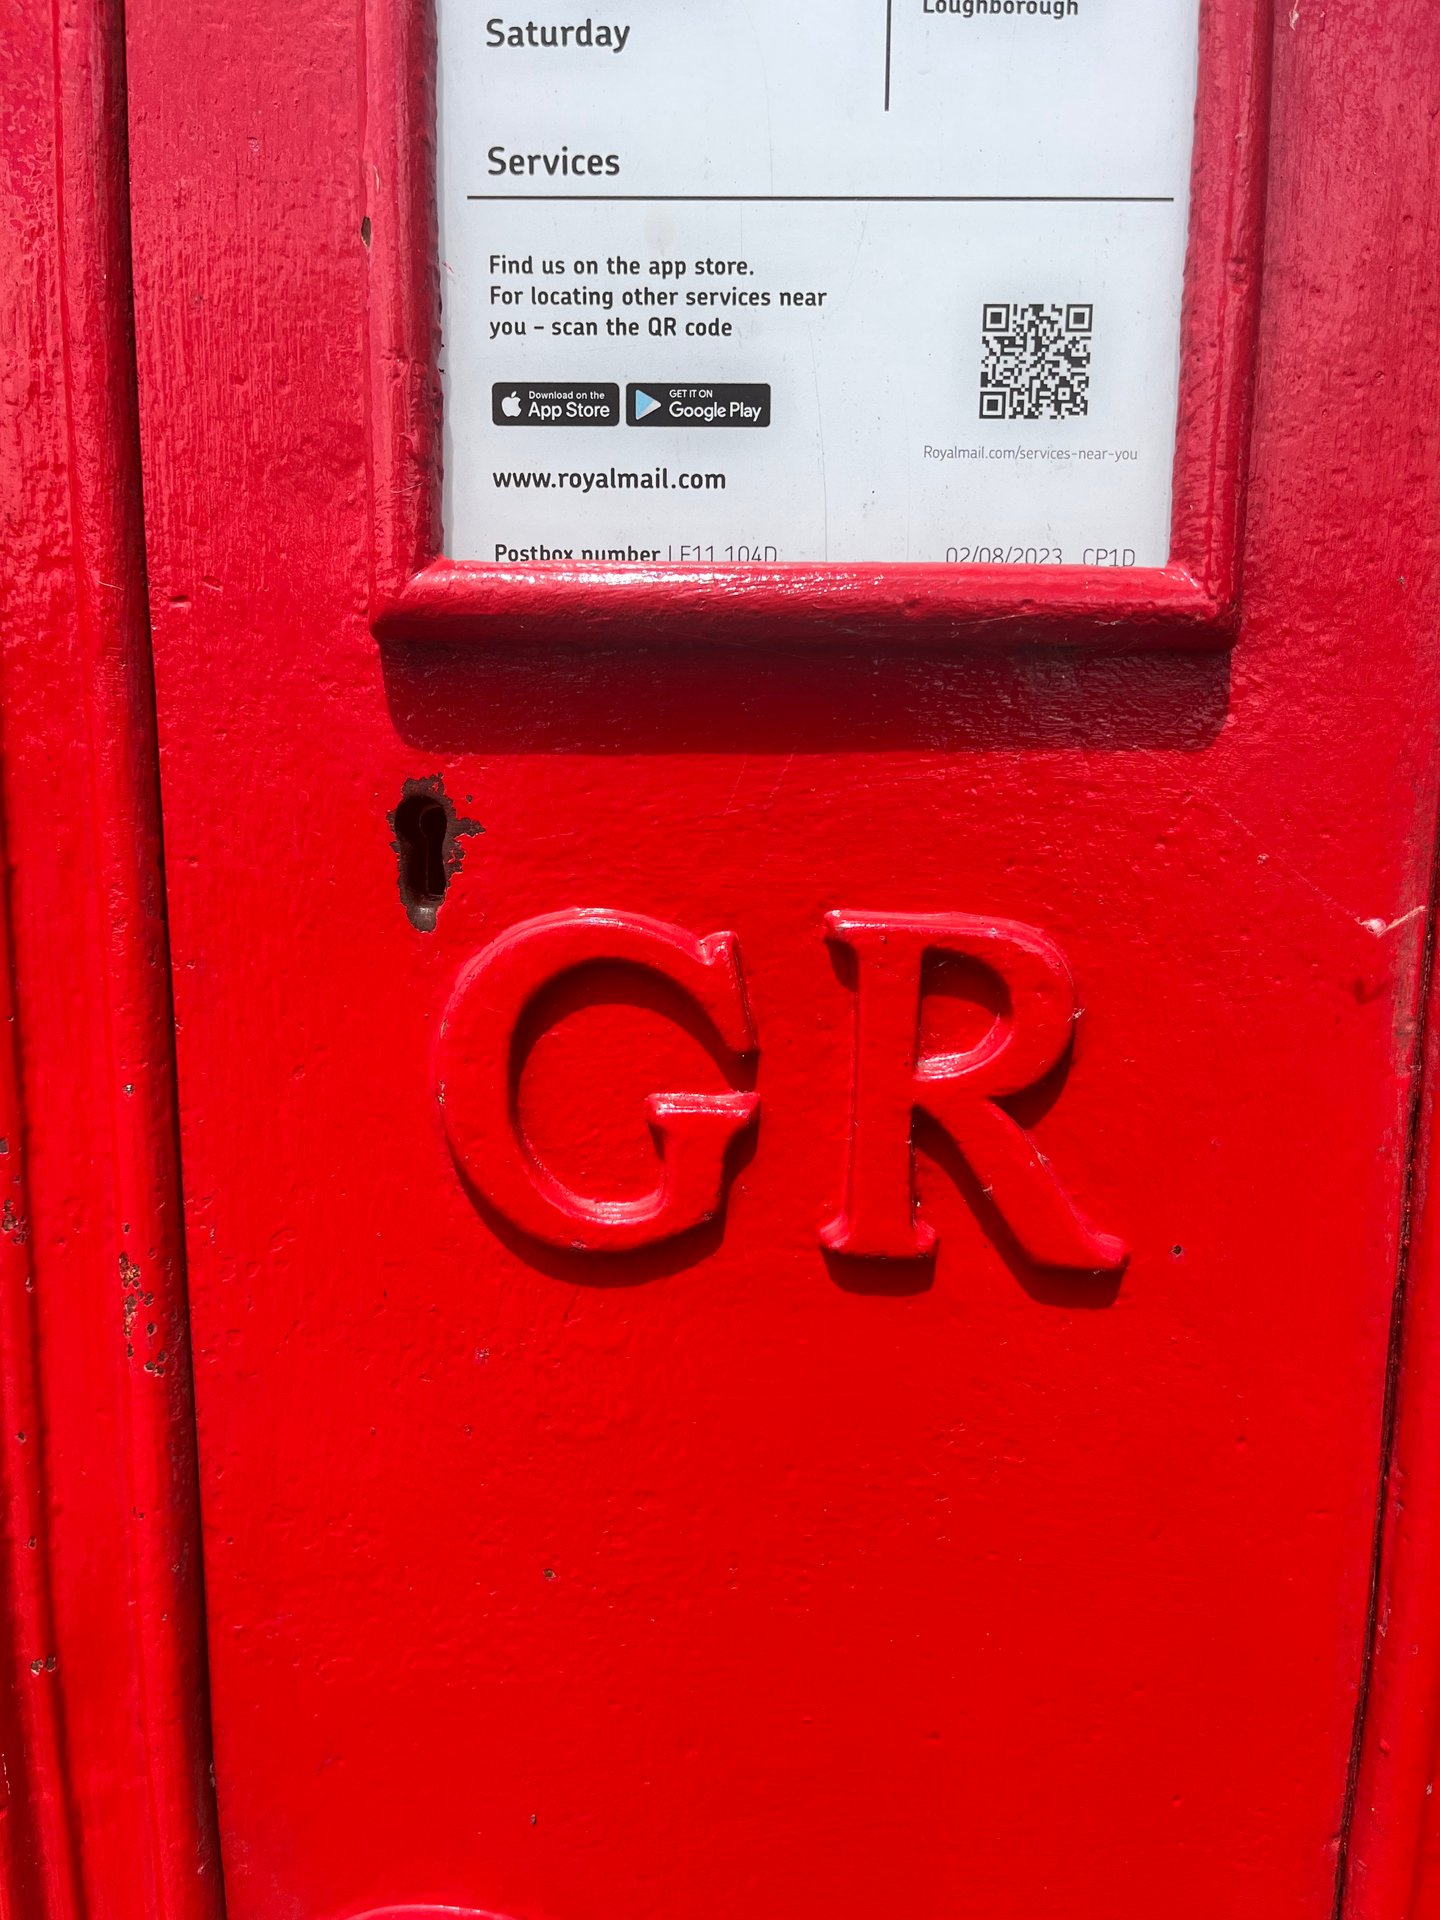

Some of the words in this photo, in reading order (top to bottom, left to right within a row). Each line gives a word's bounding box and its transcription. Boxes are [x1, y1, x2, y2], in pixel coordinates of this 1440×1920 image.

[922, 0, 1079, 20] Loughborough
[486, 18, 631, 54] Saturday
[487, 146, 621, 177] Services
[489, 255, 534, 275] Find
[542, 259, 566, 275] us
[573, 260, 599, 275] on
[606, 256, 641, 276] the
[648, 260, 687, 280] app
[694, 257, 755, 276] store.
[490, 286, 524, 305] For
[531, 286, 614, 310] locating
[621, 287, 679, 307] other
[685, 286, 771, 307] services
[778, 291, 828, 307] near
[489, 321, 527, 340] you
[551, 321, 598, 337] scan
[605, 317, 640, 337] the
[647, 317, 677, 338] QR
[684, 317, 733, 337] code
[528, 391, 574, 400] Download
[576, 392, 588, 400] on
[590, 391, 605, 400] the
[669, 389, 688, 399] GET
[689, 389, 697, 399] IT
[699, 389, 713, 399] ON
[528, 402, 562, 421] App
[566, 401, 611, 418] Store
[669, 401, 727, 423] Google
[729, 401, 762, 422] Play
[923, 445, 1138, 463] Royalmail.com/services-near-you
[493, 467, 726, 493] www.royalmail.com
[495, 544, 573, 562] Postbox
[581, 545, 661, 562] number
[946, 546, 1062, 565] 02/08/2023
[1083, 548, 1136, 567] CP1D
